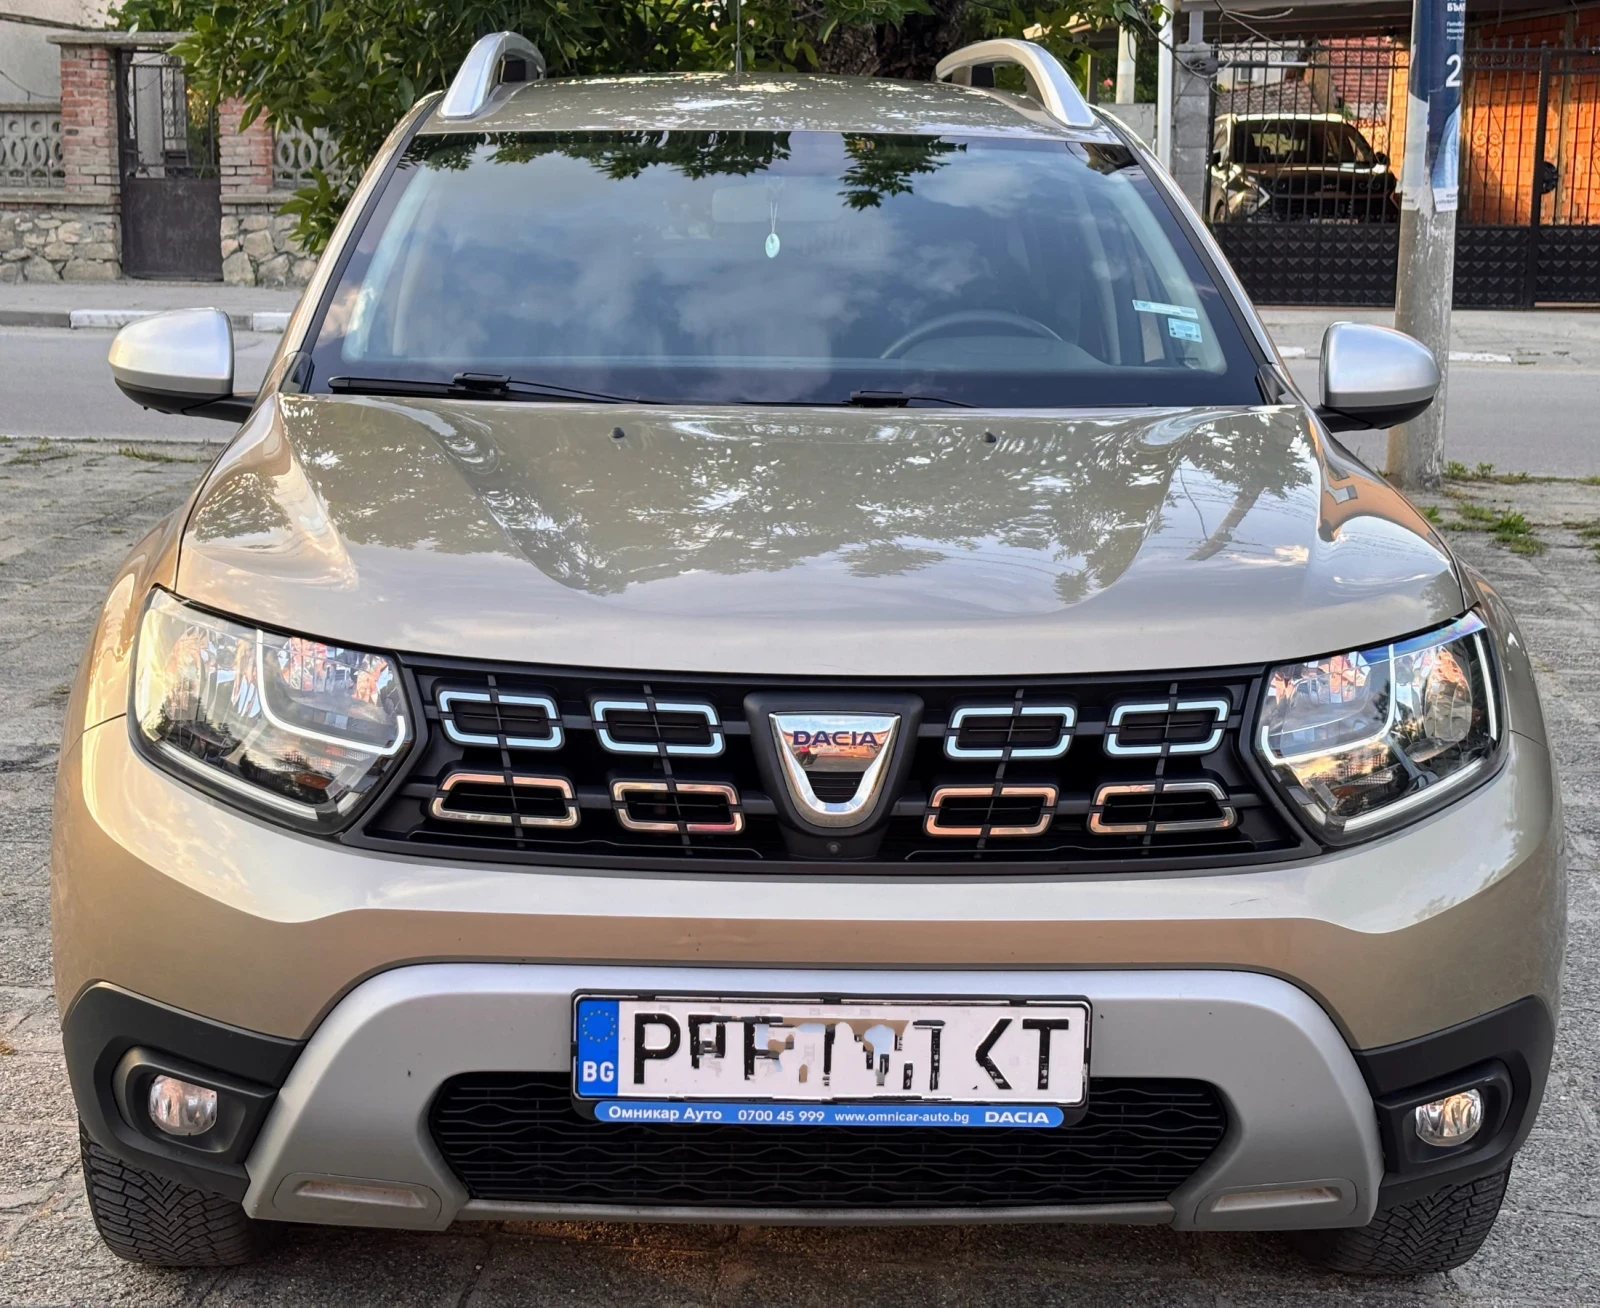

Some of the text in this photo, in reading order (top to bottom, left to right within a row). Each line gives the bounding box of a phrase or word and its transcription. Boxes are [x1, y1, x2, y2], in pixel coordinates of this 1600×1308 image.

[1446, 54, 1462, 88] 2
[793, 731, 878, 746] DACIA
[582, 1061, 615, 1083] BG
[608, 1105, 1050, 1124] Омникар Ауто 0700 45 999 www.omnicar-auto.bg DACIA
